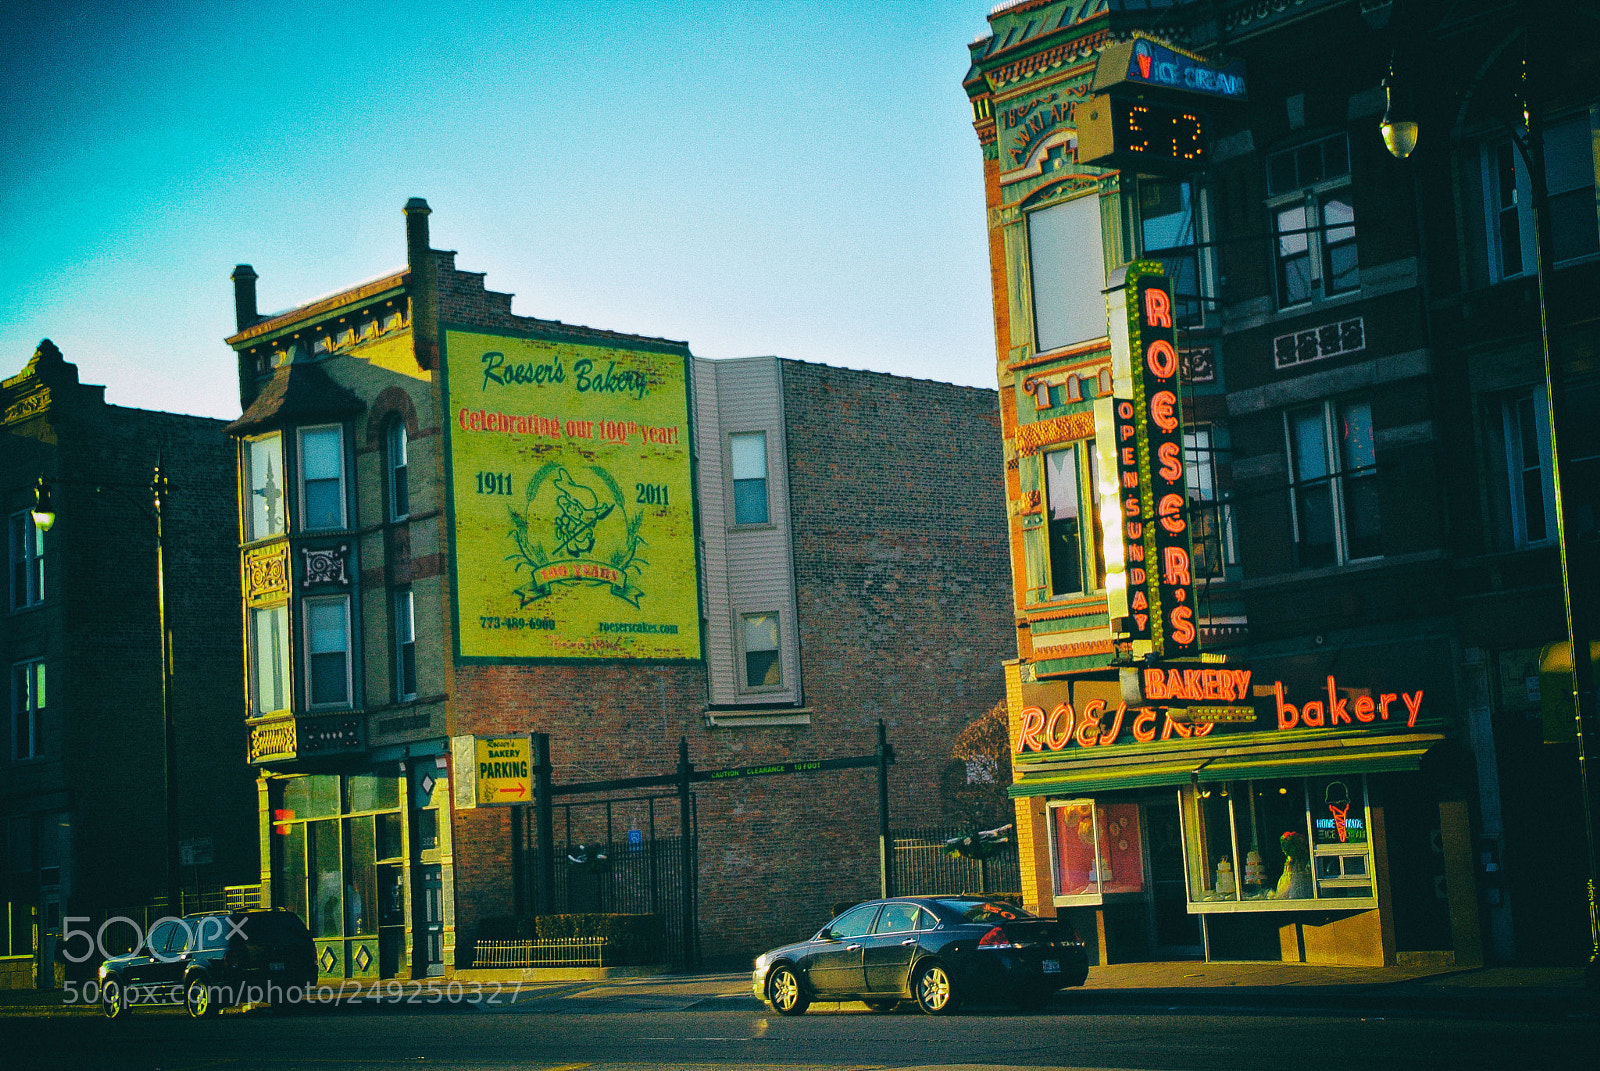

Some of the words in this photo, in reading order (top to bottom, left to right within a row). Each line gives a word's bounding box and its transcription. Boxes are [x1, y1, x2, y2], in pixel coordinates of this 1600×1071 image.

[482, 351, 566, 391] Roeser's
[573, 358, 647, 400] Bakery
[459, 408, 561, 439] Celebrating
[566, 419, 594, 439] our
[599, 418, 638, 444] 100th
[640, 424, 679, 446] year!
[1118, 402, 1139, 487] OPEN
[1144, 287, 1196, 645] ROESER'S
[475, 471, 513, 496] 1911
[635, 482, 670, 506] 2011
[541, 565, 568, 580] 100
[1125, 498, 1149, 632] SUNDAY
[599, 621, 679, 635] roeserscakes.com
[1144, 668, 1252, 702] BAKERY
[1274, 675, 1424, 730] bakery
[488, 749, 520, 758] BAKERY
[480, 761, 528, 779] PARKING
[711, 770, 739, 779] CAUTION
[746, 765, 785, 775] CLEARANCE
[1316, 818, 1336, 829] HOME
